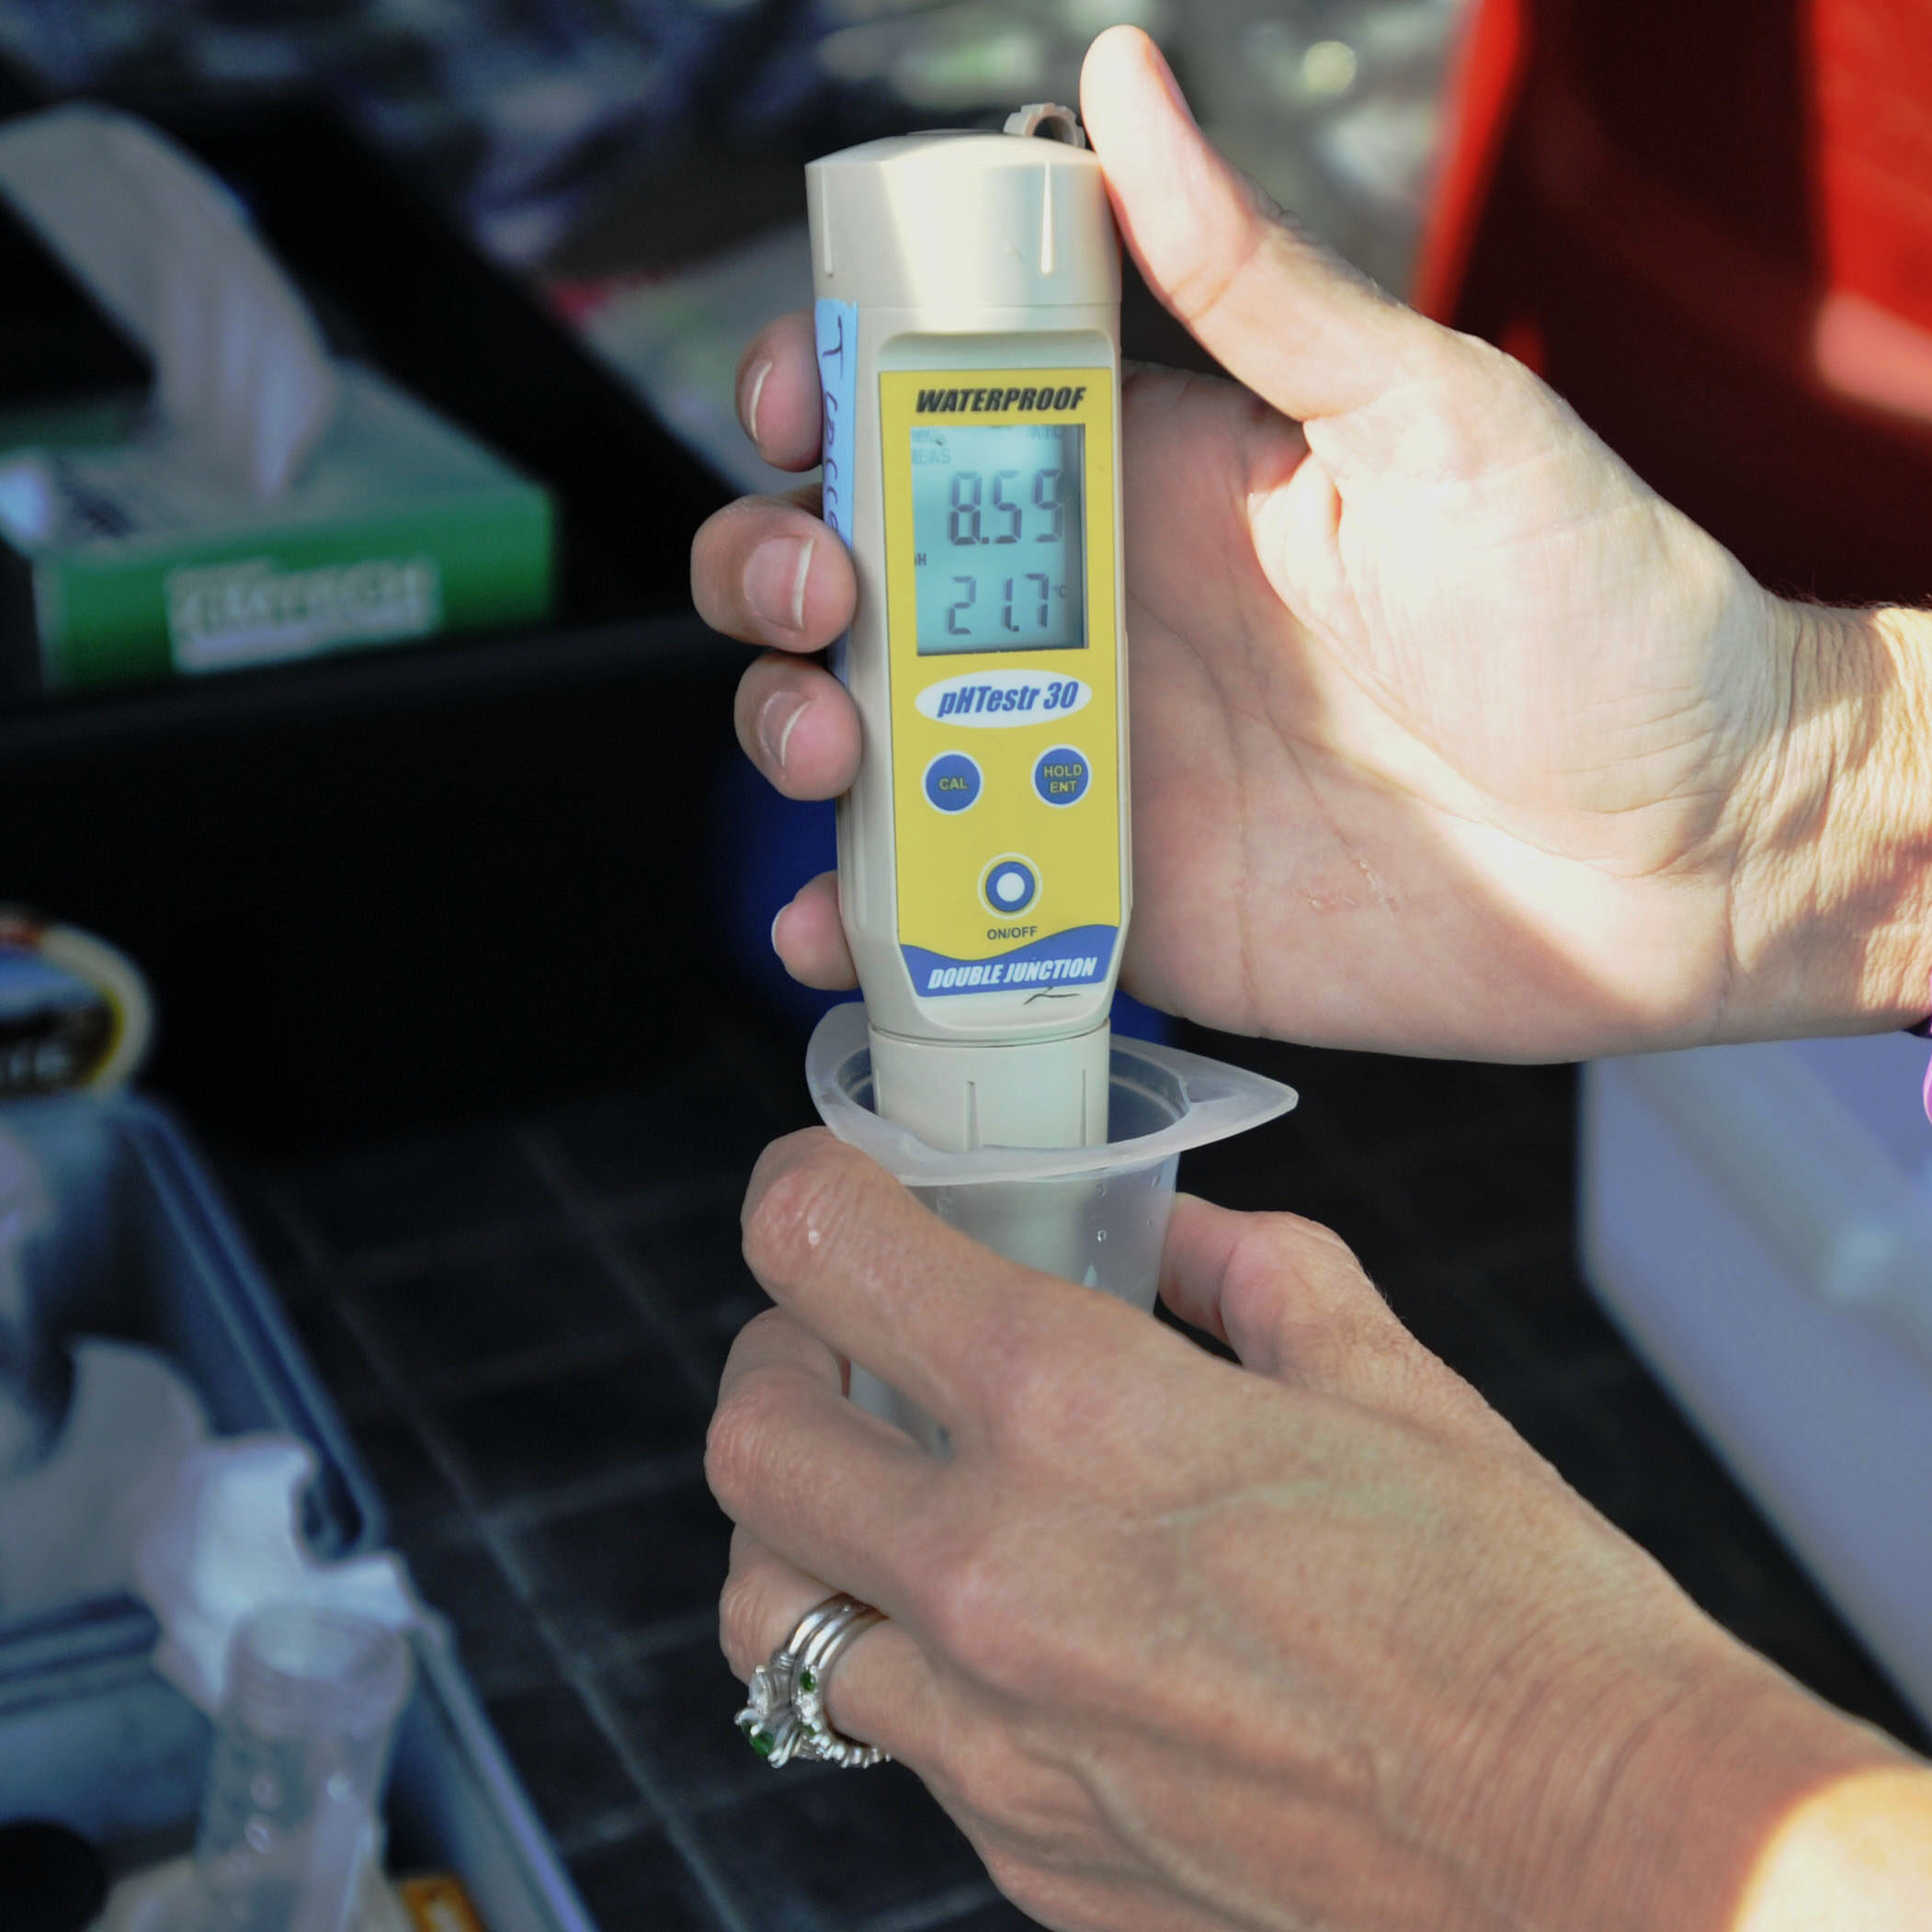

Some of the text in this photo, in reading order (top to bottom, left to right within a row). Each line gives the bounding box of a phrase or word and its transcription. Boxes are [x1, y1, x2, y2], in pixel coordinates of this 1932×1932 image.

[915, 387, 1086, 413] WATERPROOF
[948, 572, 1050, 635] 21.7
[937, 681, 1080, 719] pHTestr 30
[1043, 764, 1083, 778] HOLD
[938, 777, 969, 791] CAL
[1050, 779, 1077, 794] ENT
[986, 926, 1038, 940] ON/OFF
[927, 957, 1097, 989] DOUBLE JUNCTION
